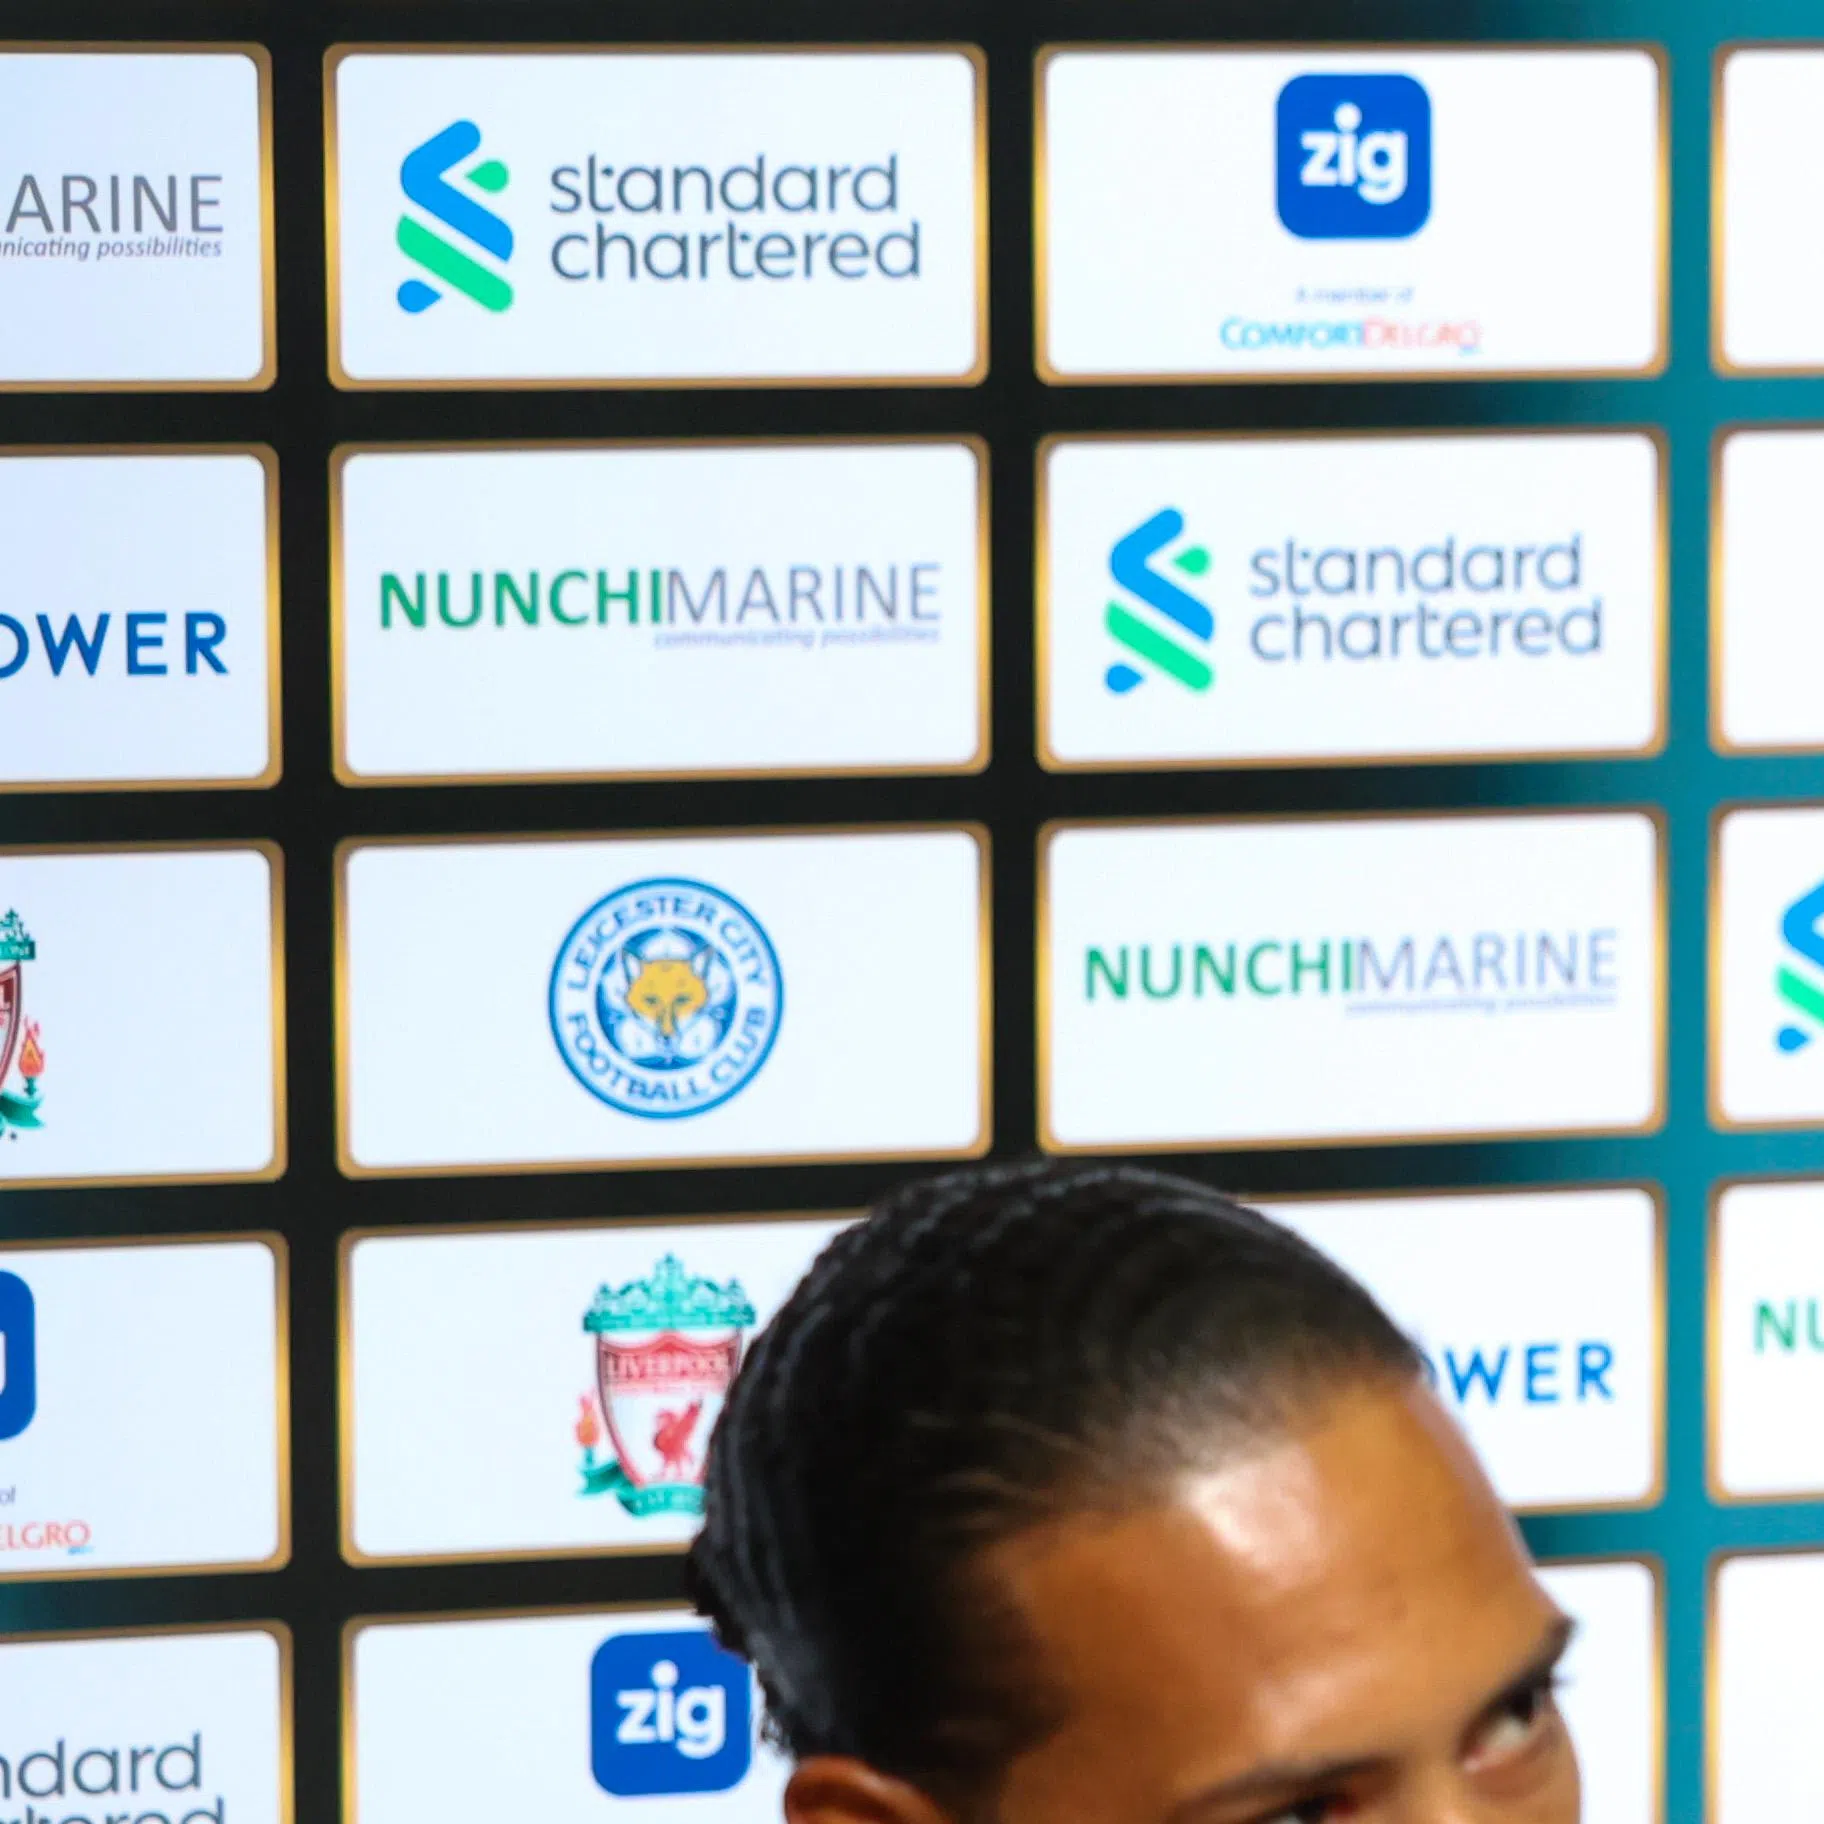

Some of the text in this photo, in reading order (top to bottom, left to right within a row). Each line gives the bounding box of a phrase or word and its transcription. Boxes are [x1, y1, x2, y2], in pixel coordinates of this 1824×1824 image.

[547, 150, 899, 218] standard
[1299, 101, 1409, 206] zig
[96, 236, 223, 261] possibilities
[547, 215, 922, 284] chartered
[379, 562, 941, 630] NUNCHIMARINE
[1248, 532, 1581, 597] standard
[1248, 595, 1606, 664] chartered
[1083, 926, 1621, 1004] NUNCHIMARINE
[616, 1659, 727, 1760] zig
